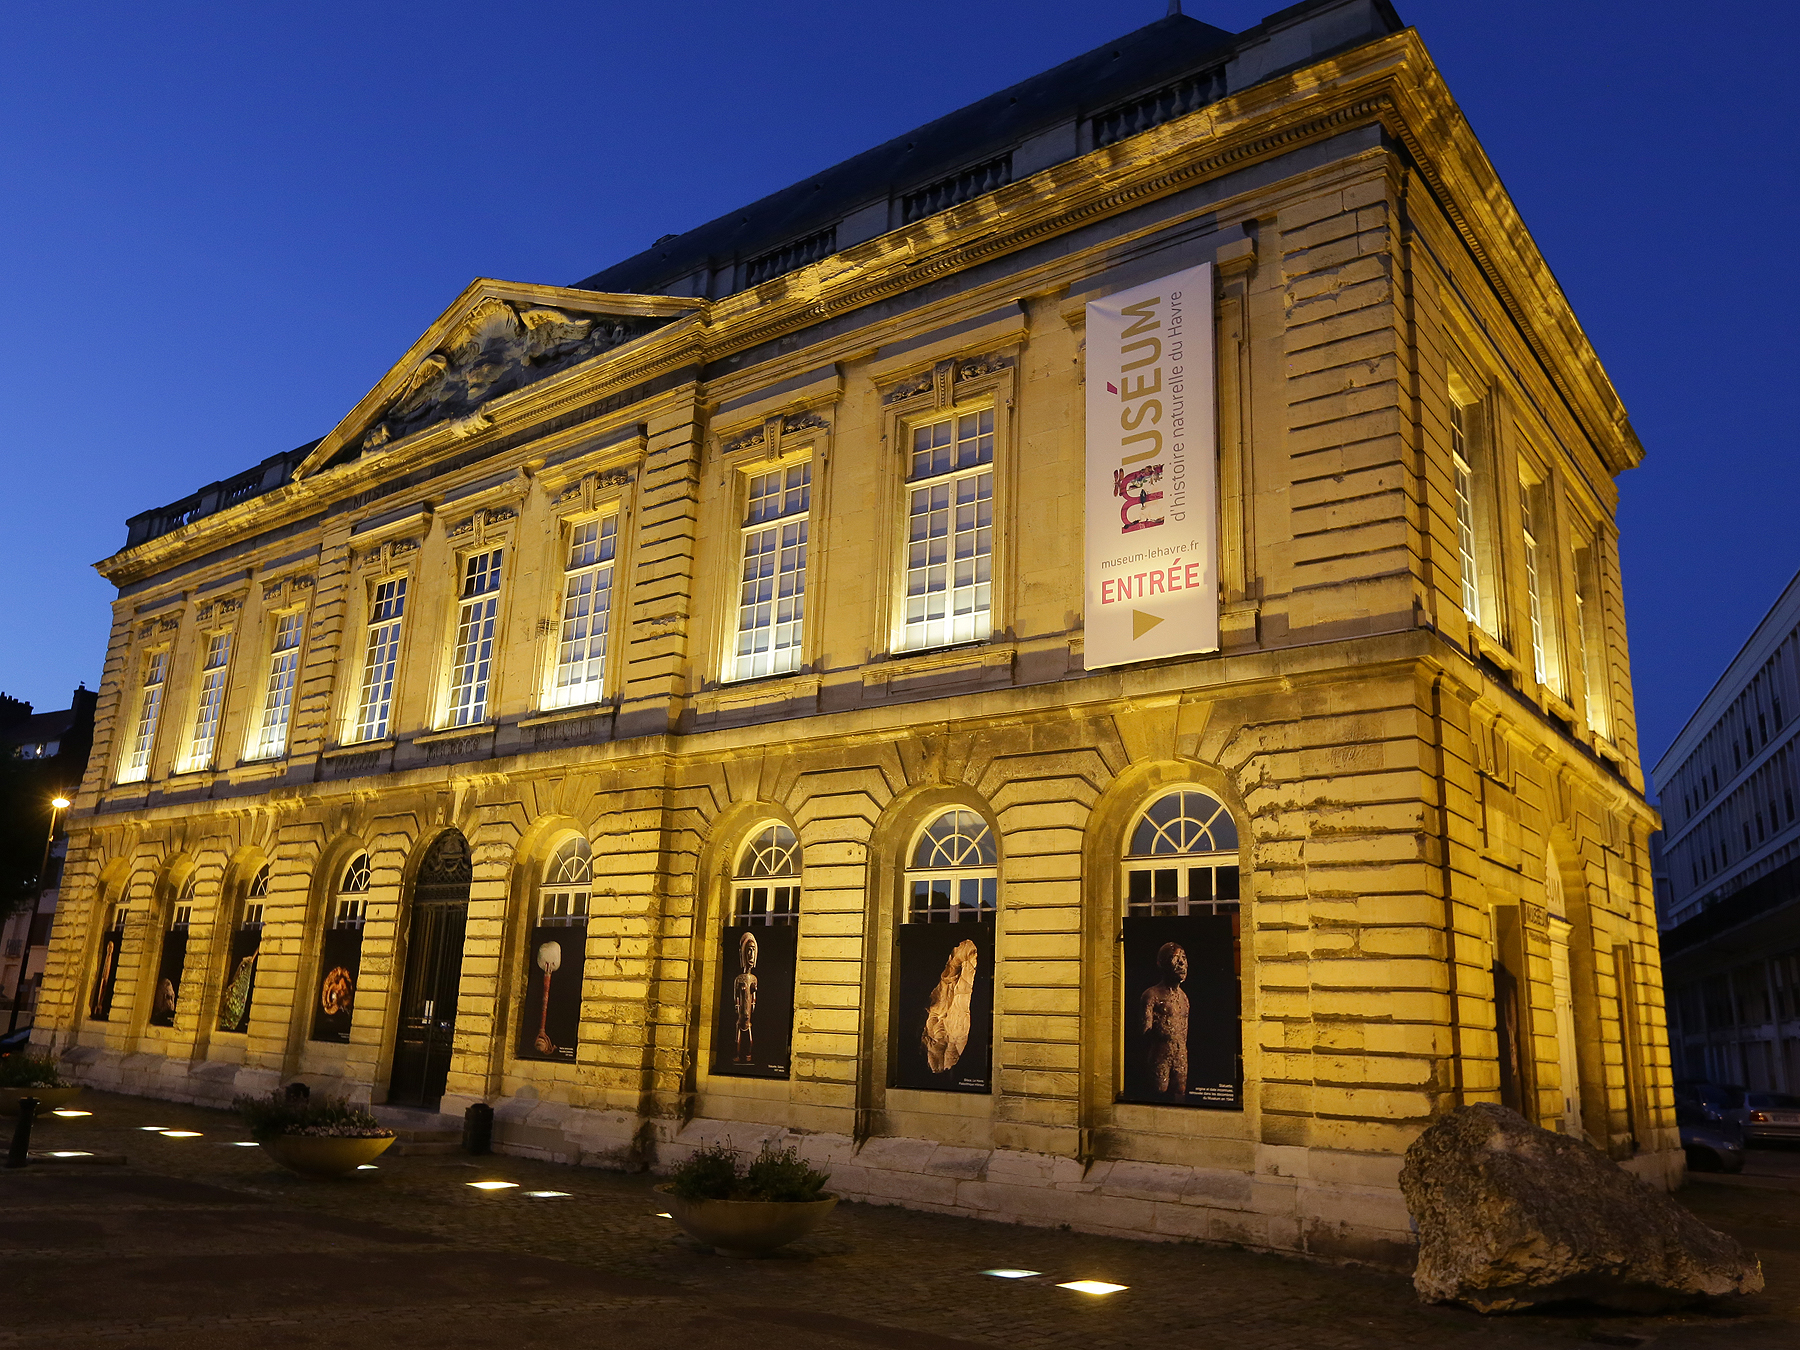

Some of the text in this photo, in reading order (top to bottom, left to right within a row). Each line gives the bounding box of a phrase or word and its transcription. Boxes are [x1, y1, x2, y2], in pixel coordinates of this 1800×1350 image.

[1167, 291, 1186, 522] d'histoire naturelle du Havre
[1101, 540, 1199, 569] museum-lehavre.fr
[1102, 557, 1200, 605] ENTRÉE
